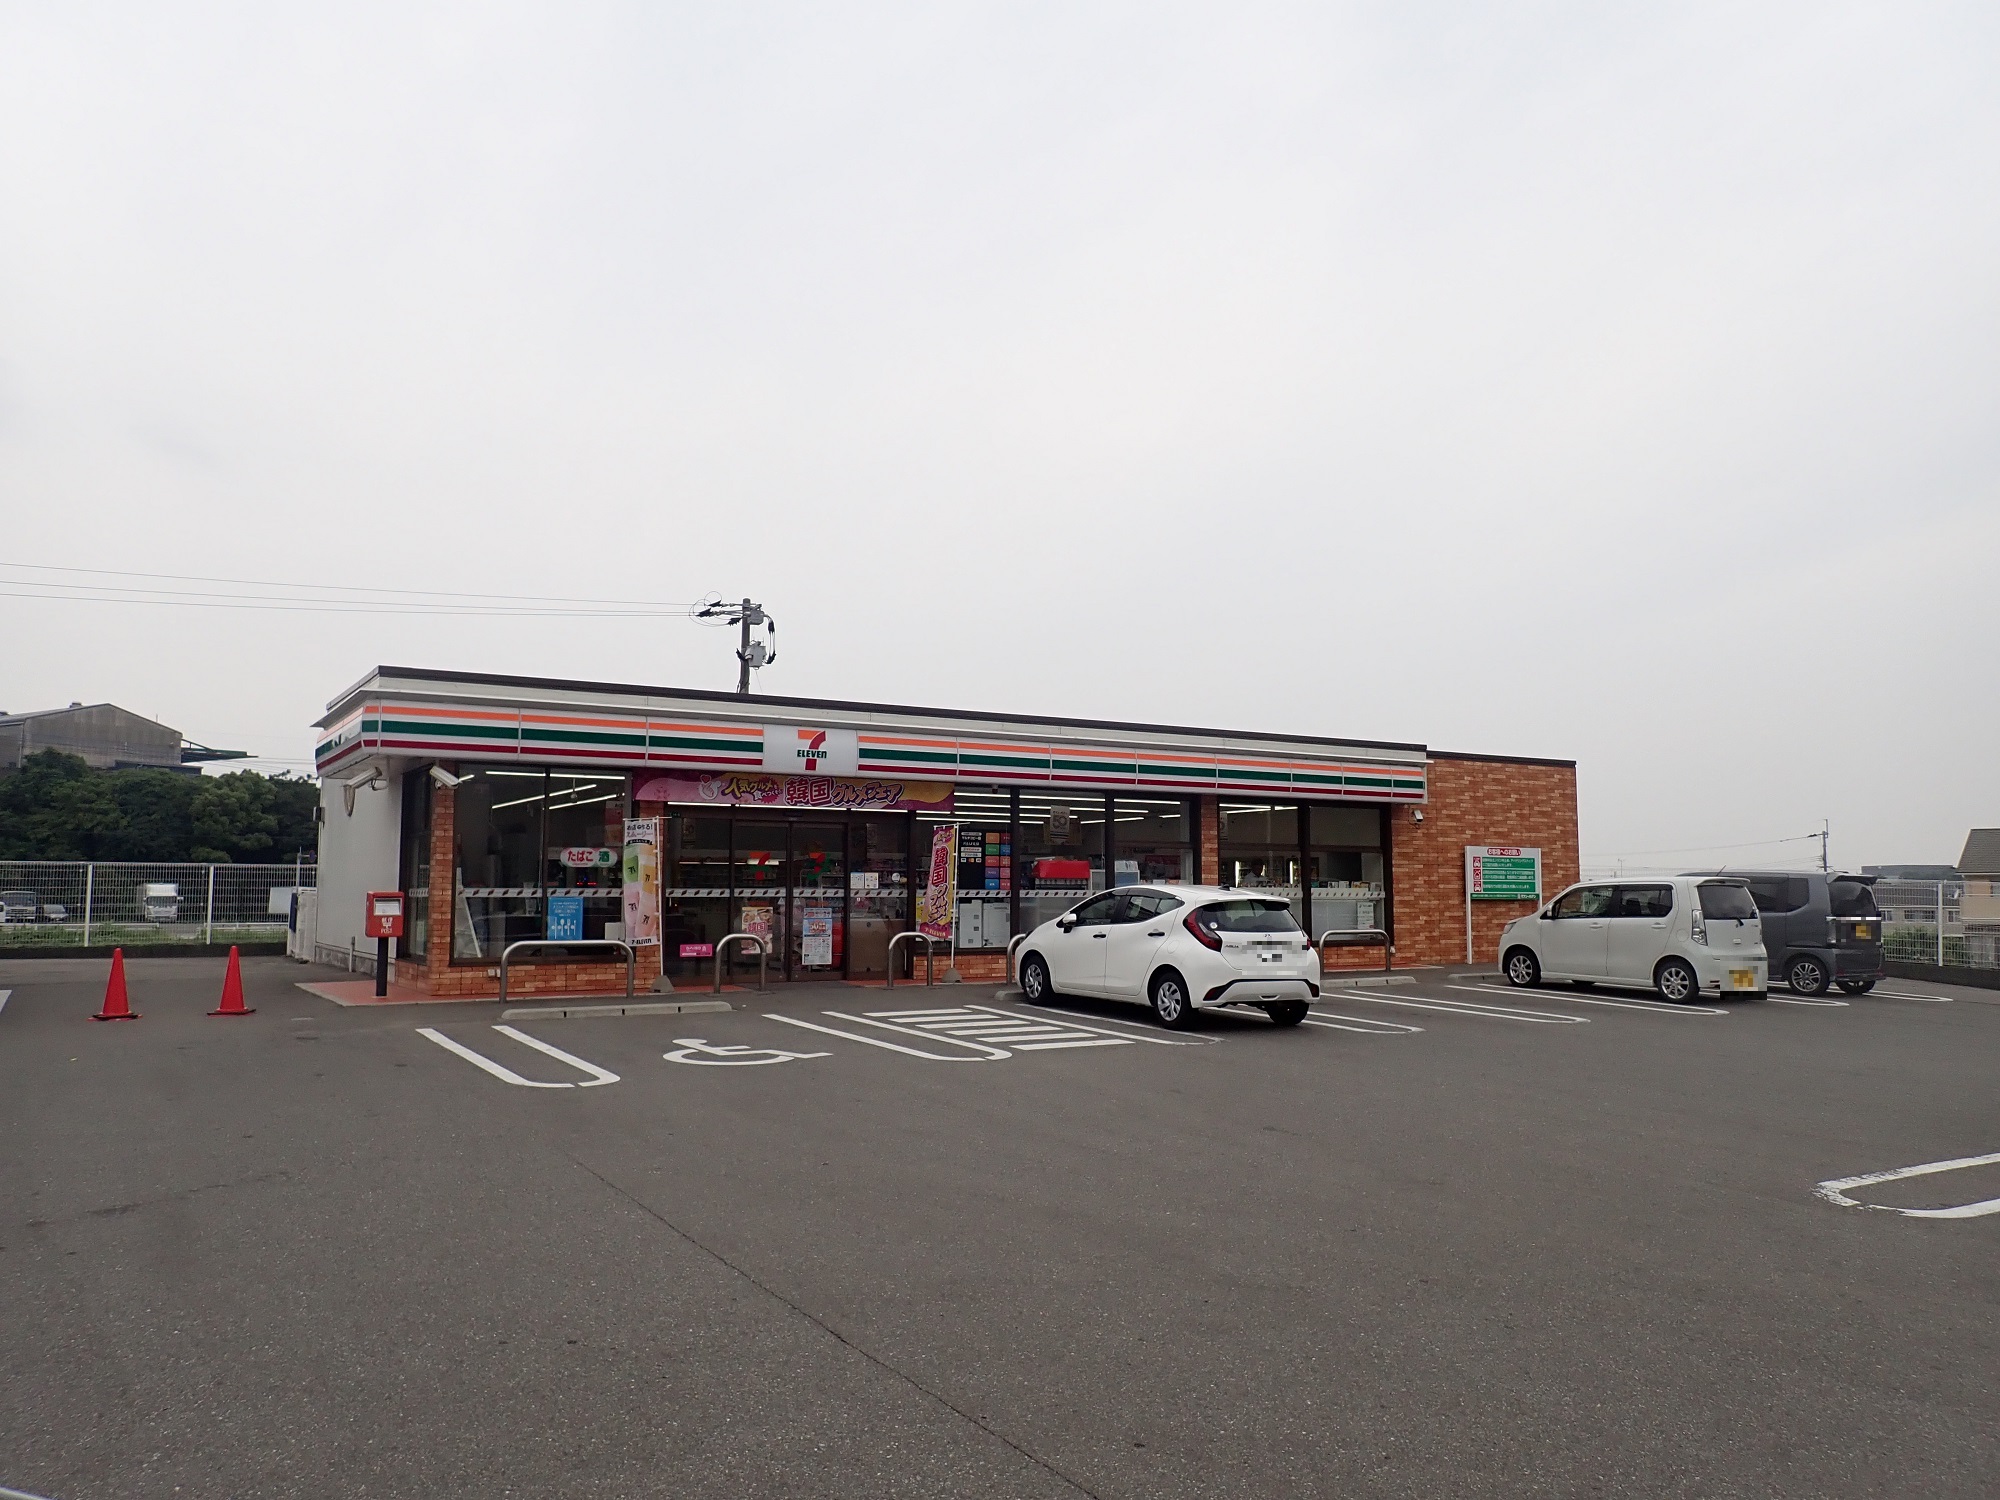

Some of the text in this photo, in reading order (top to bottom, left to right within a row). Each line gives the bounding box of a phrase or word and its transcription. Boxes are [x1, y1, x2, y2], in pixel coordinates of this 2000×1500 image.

[567, 850, 610, 862] たばこ 酒
